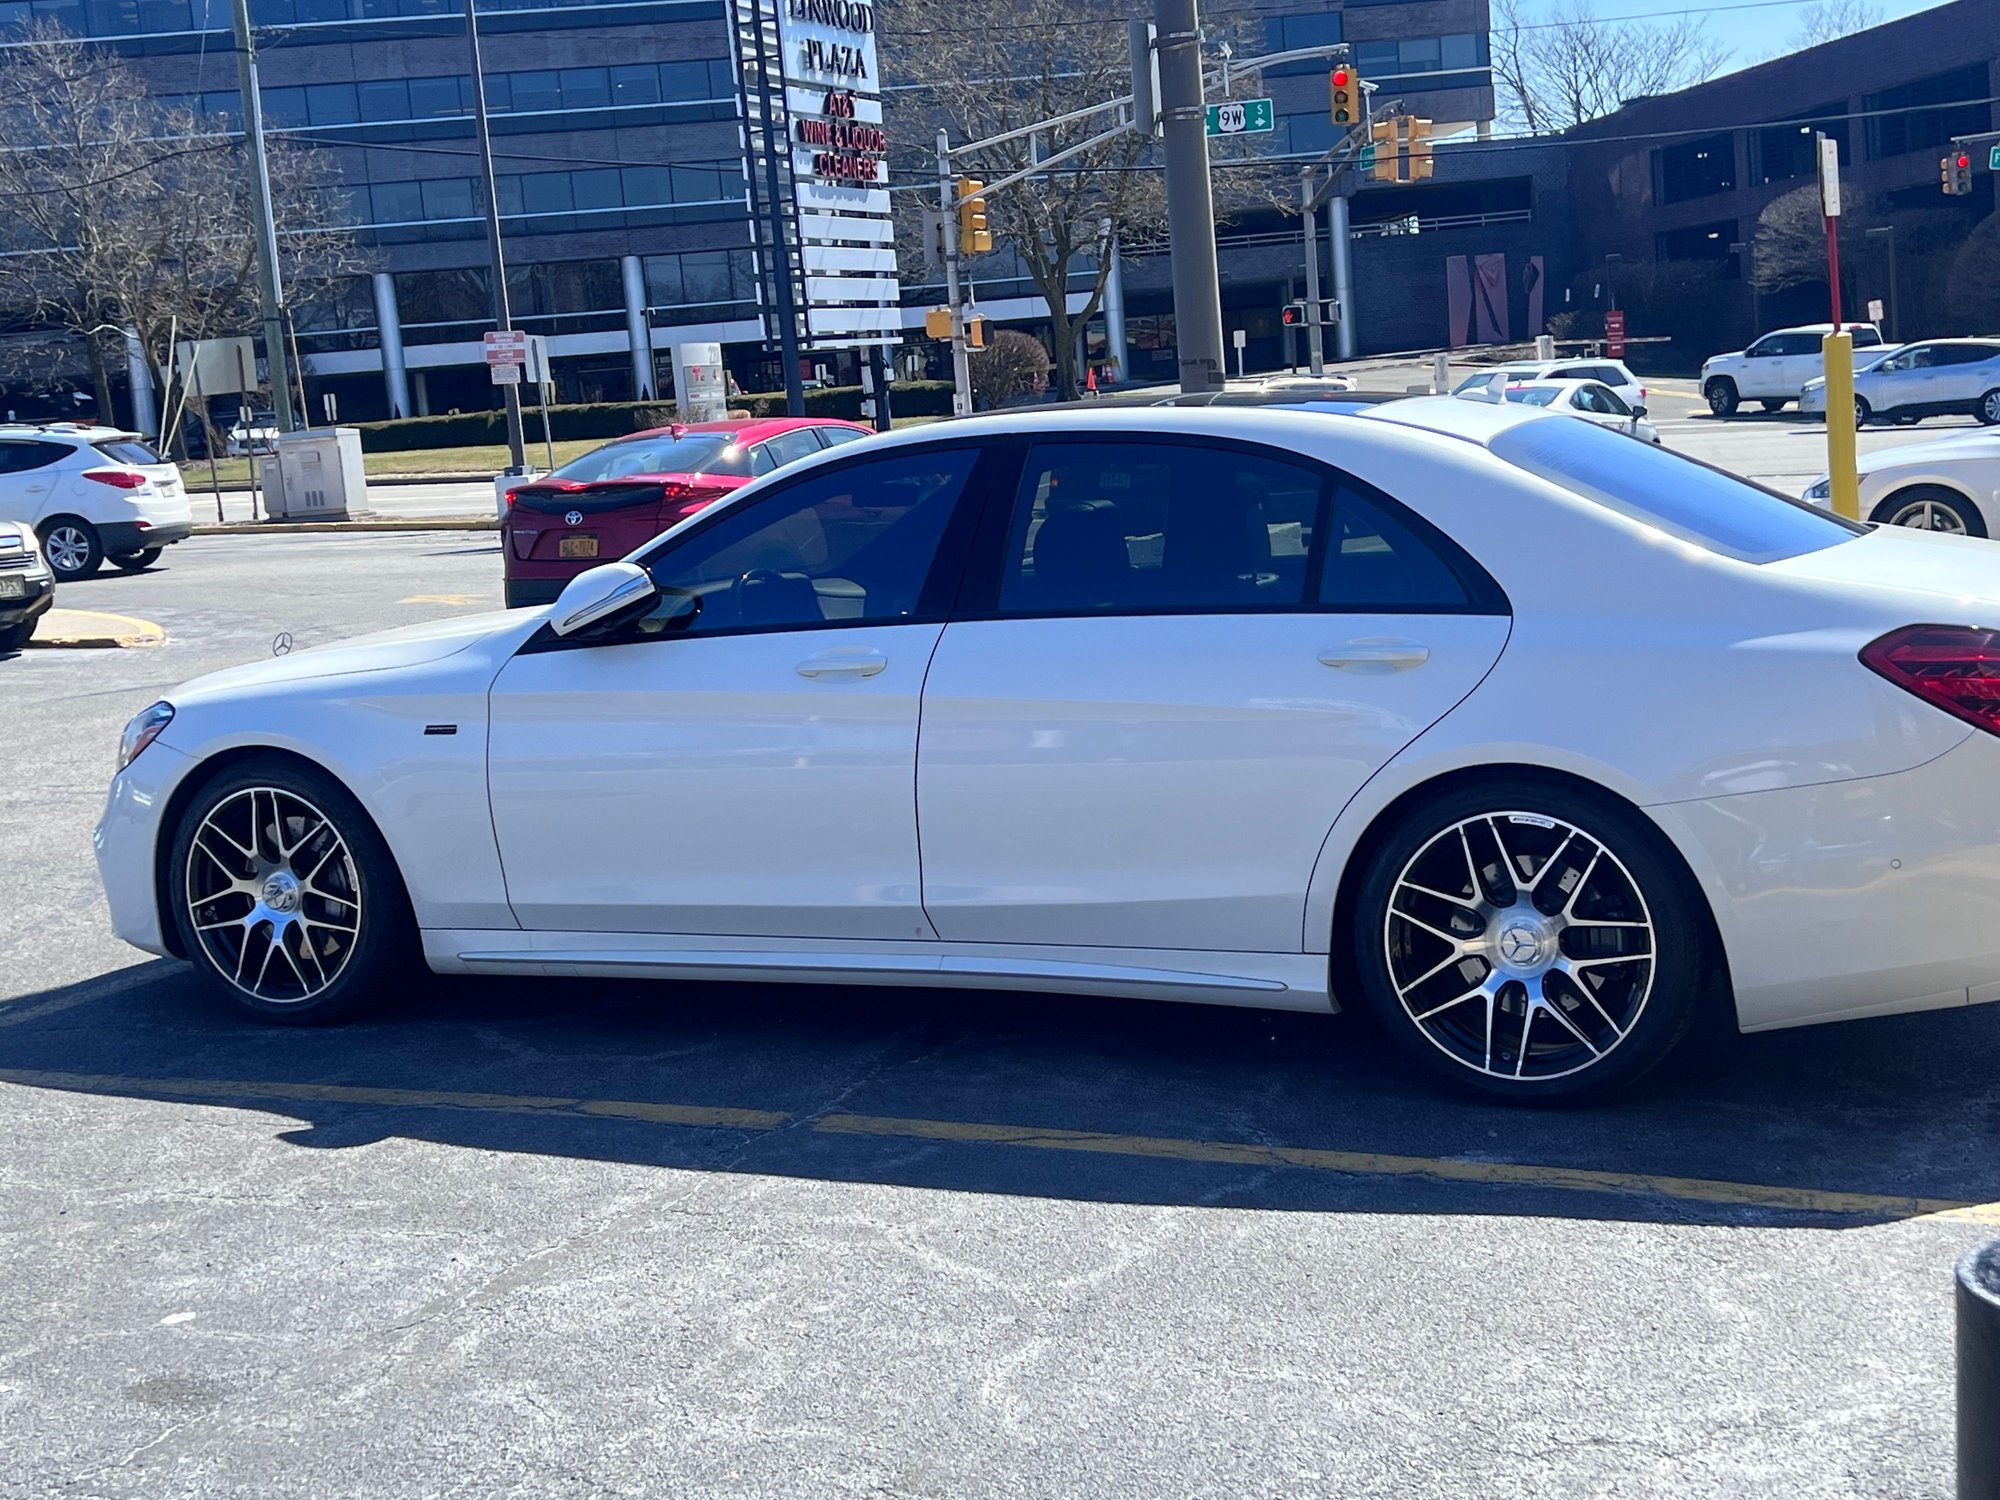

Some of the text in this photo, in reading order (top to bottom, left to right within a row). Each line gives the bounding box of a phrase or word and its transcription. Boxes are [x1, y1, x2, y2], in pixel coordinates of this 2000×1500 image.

[805, 38, 869, 80] PLAZA
[828, 91, 857, 119] AT&T
[1221, 104, 1264, 127] 9W S
[802, 119, 886, 152] WINE & LIQUOR
[818, 152, 879, 181] CLEANERS
